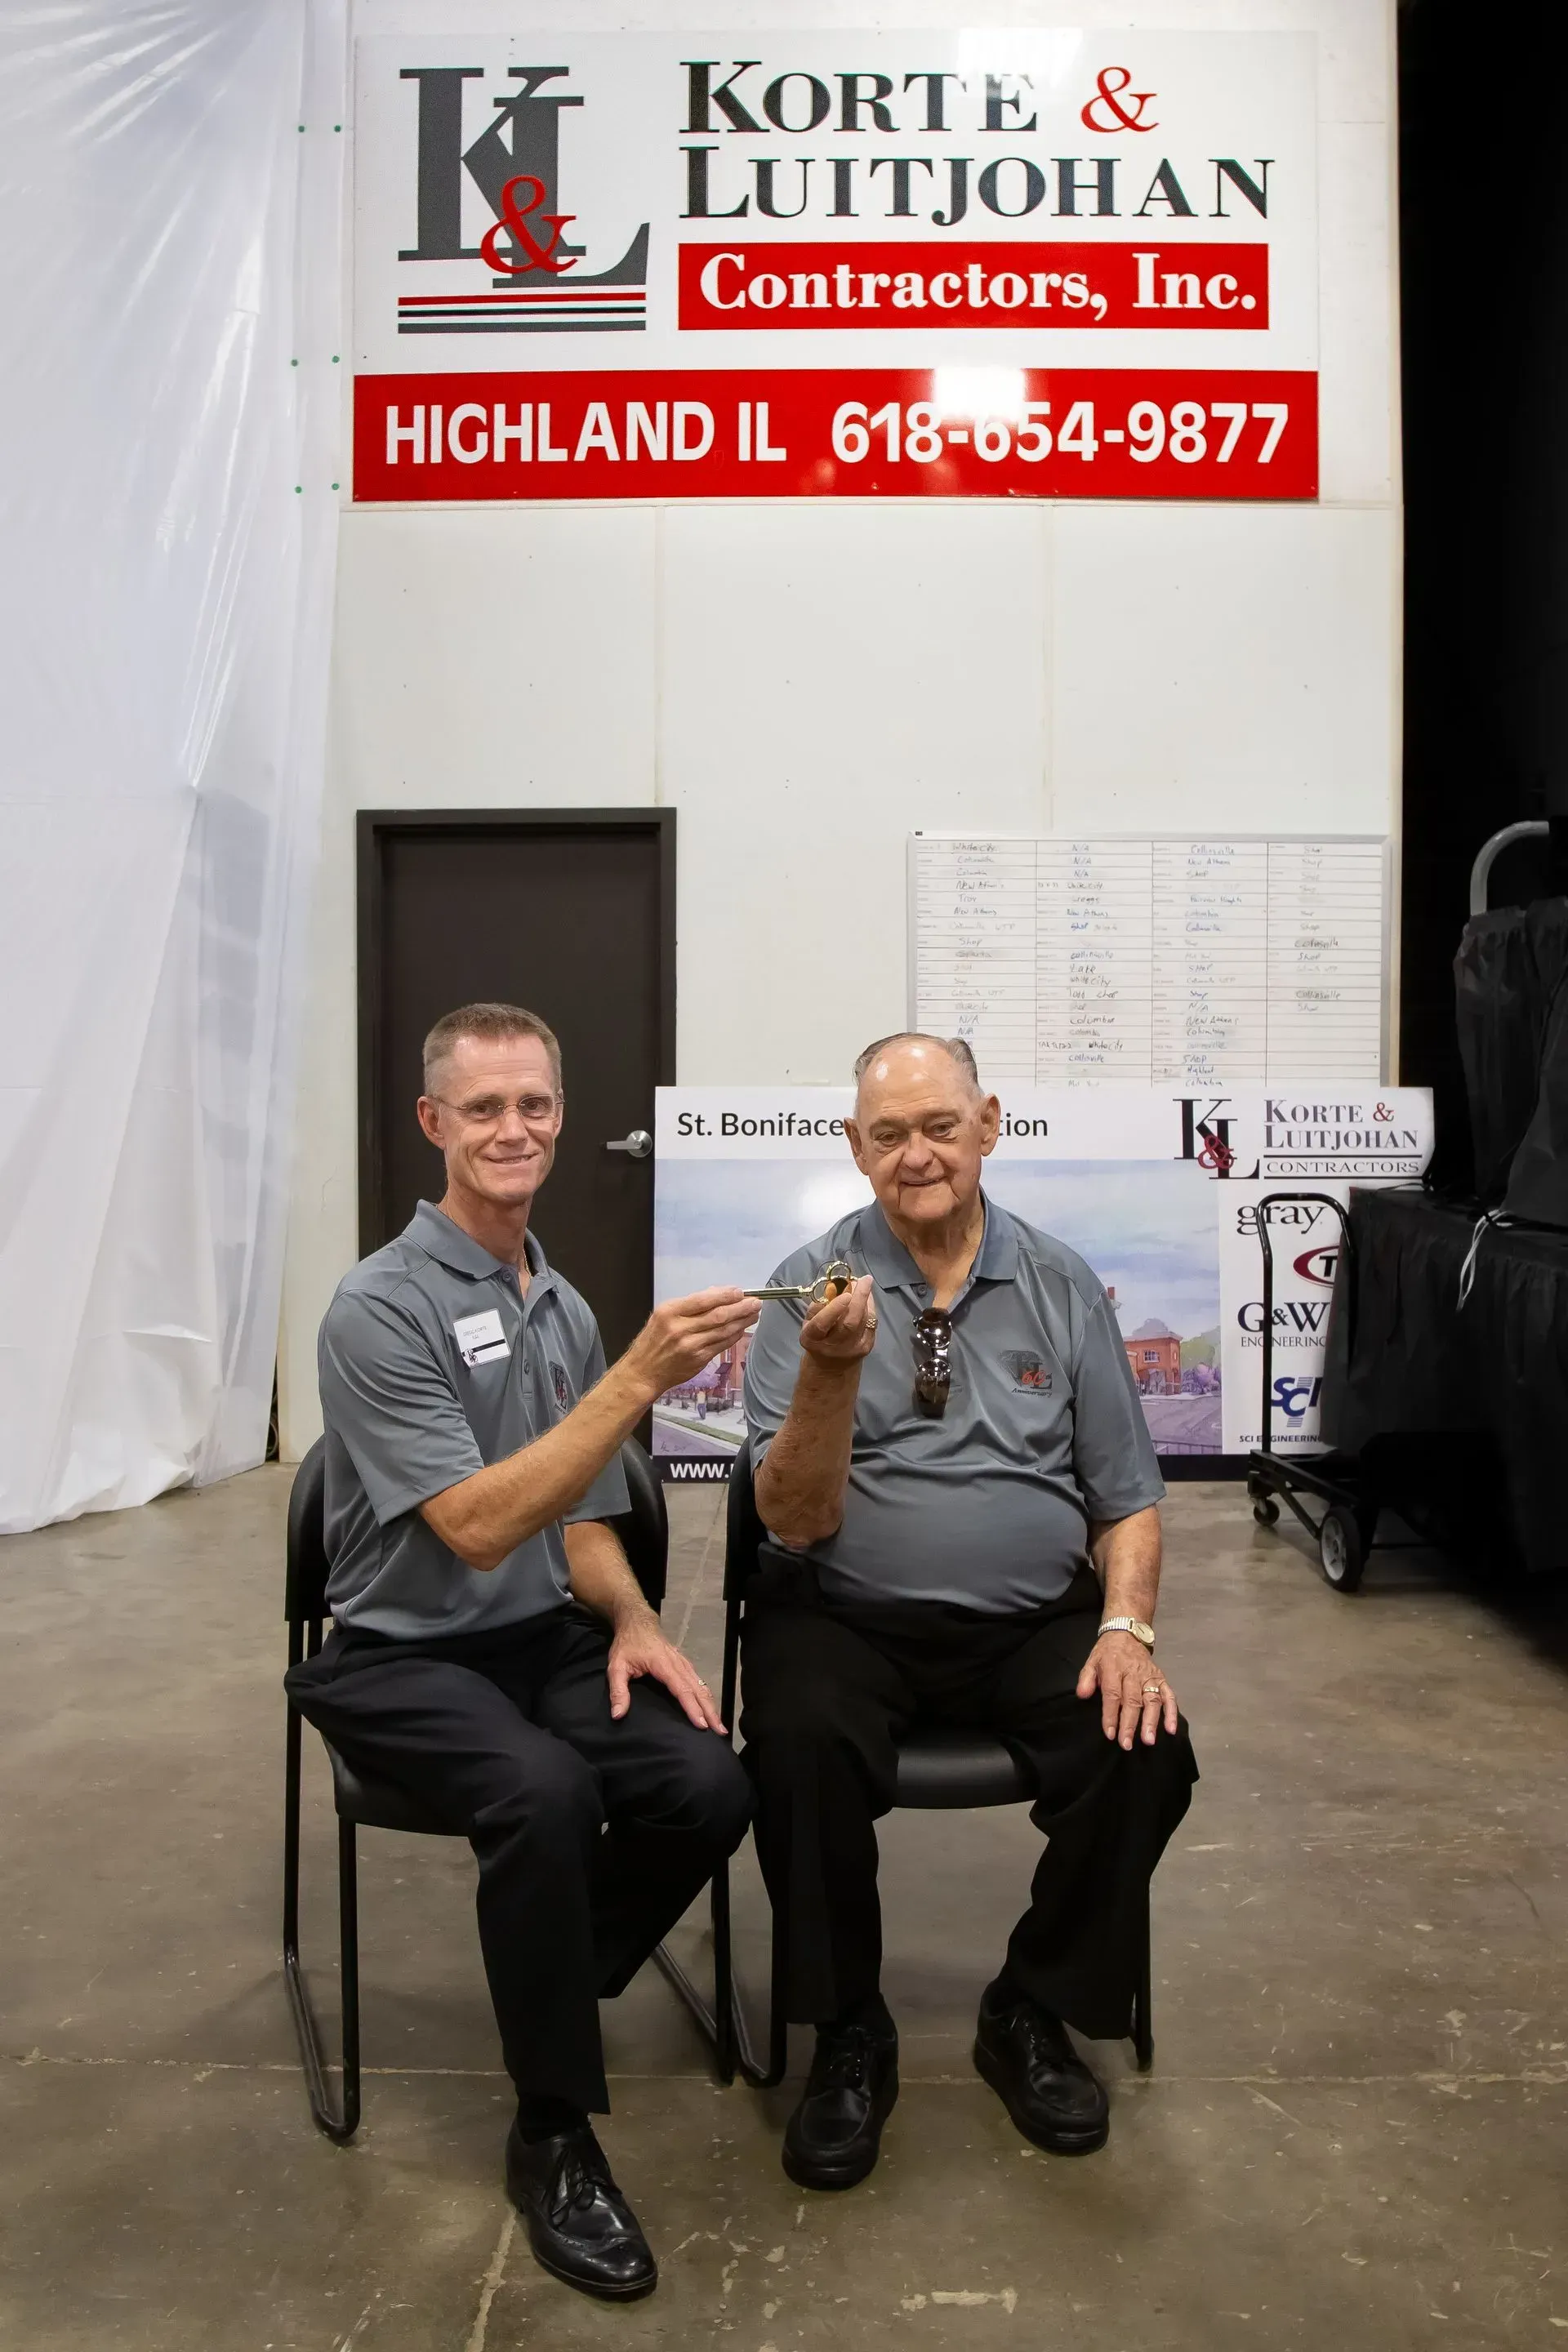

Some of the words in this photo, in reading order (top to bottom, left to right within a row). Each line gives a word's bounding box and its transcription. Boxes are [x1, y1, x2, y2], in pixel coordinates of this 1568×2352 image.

[679, 60, 1037, 135] KORTE
[1080, 66, 1160, 134] &
[679, 145, 1276, 228] LUITJOHAN
[699, 255, 1107, 322] Contractors,
[1131, 253, 1258, 310] Inc.
[385, 402, 715, 466] HIGHLAND
[737, 403, 787, 464] IL
[830, 401, 1290, 466] 618-654-9877
[677, 1112, 713, 1136] St.
[721, 1112, 844, 1136] Boniface
[1264, 1099, 1364, 1124] KORTE
[1372, 1102, 1395, 1123] &
[1264, 1125, 1419, 1152] LUITJOHAN
[1267, 1161, 1419, 1174] CONTRACTORS
[1239, 1435, 1254, 1443] SCI
